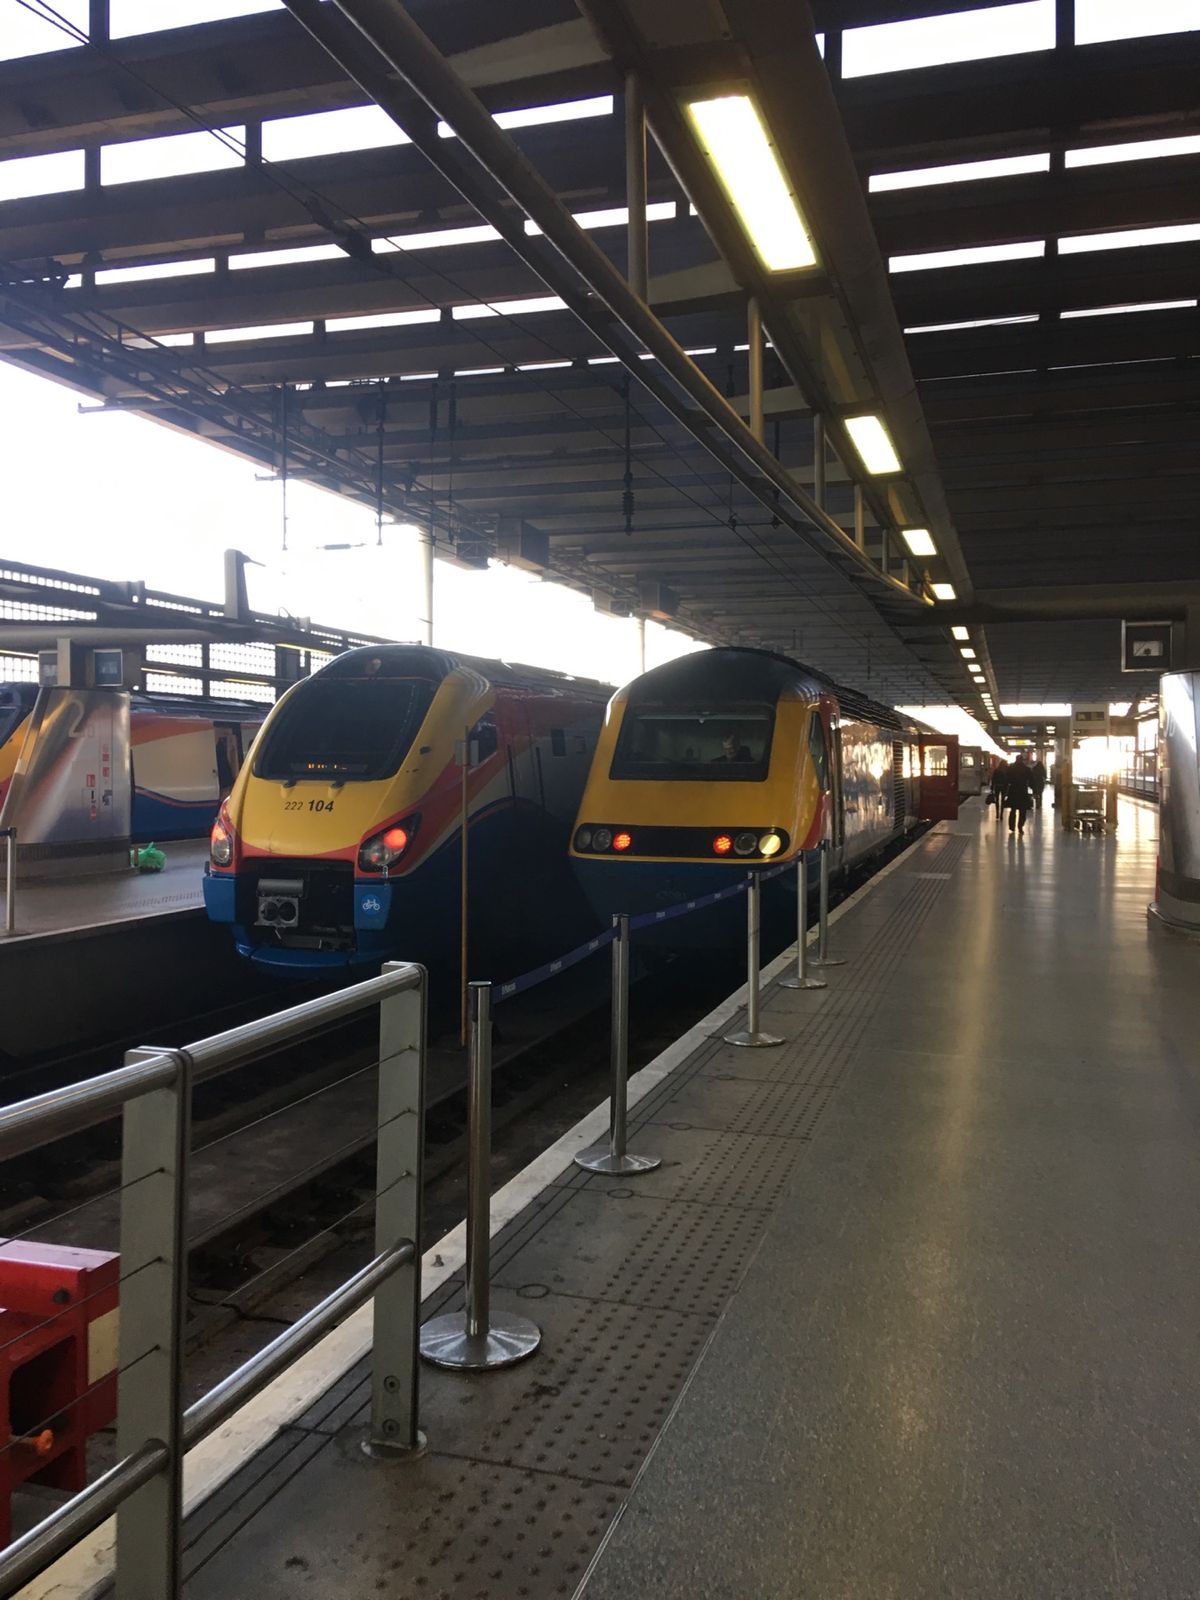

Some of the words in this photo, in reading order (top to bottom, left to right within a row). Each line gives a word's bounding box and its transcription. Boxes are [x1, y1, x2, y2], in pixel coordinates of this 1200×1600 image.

[68, 699, 85, 738] 2
[284, 801, 304, 811] 222
[308, 799, 335, 812] 104
